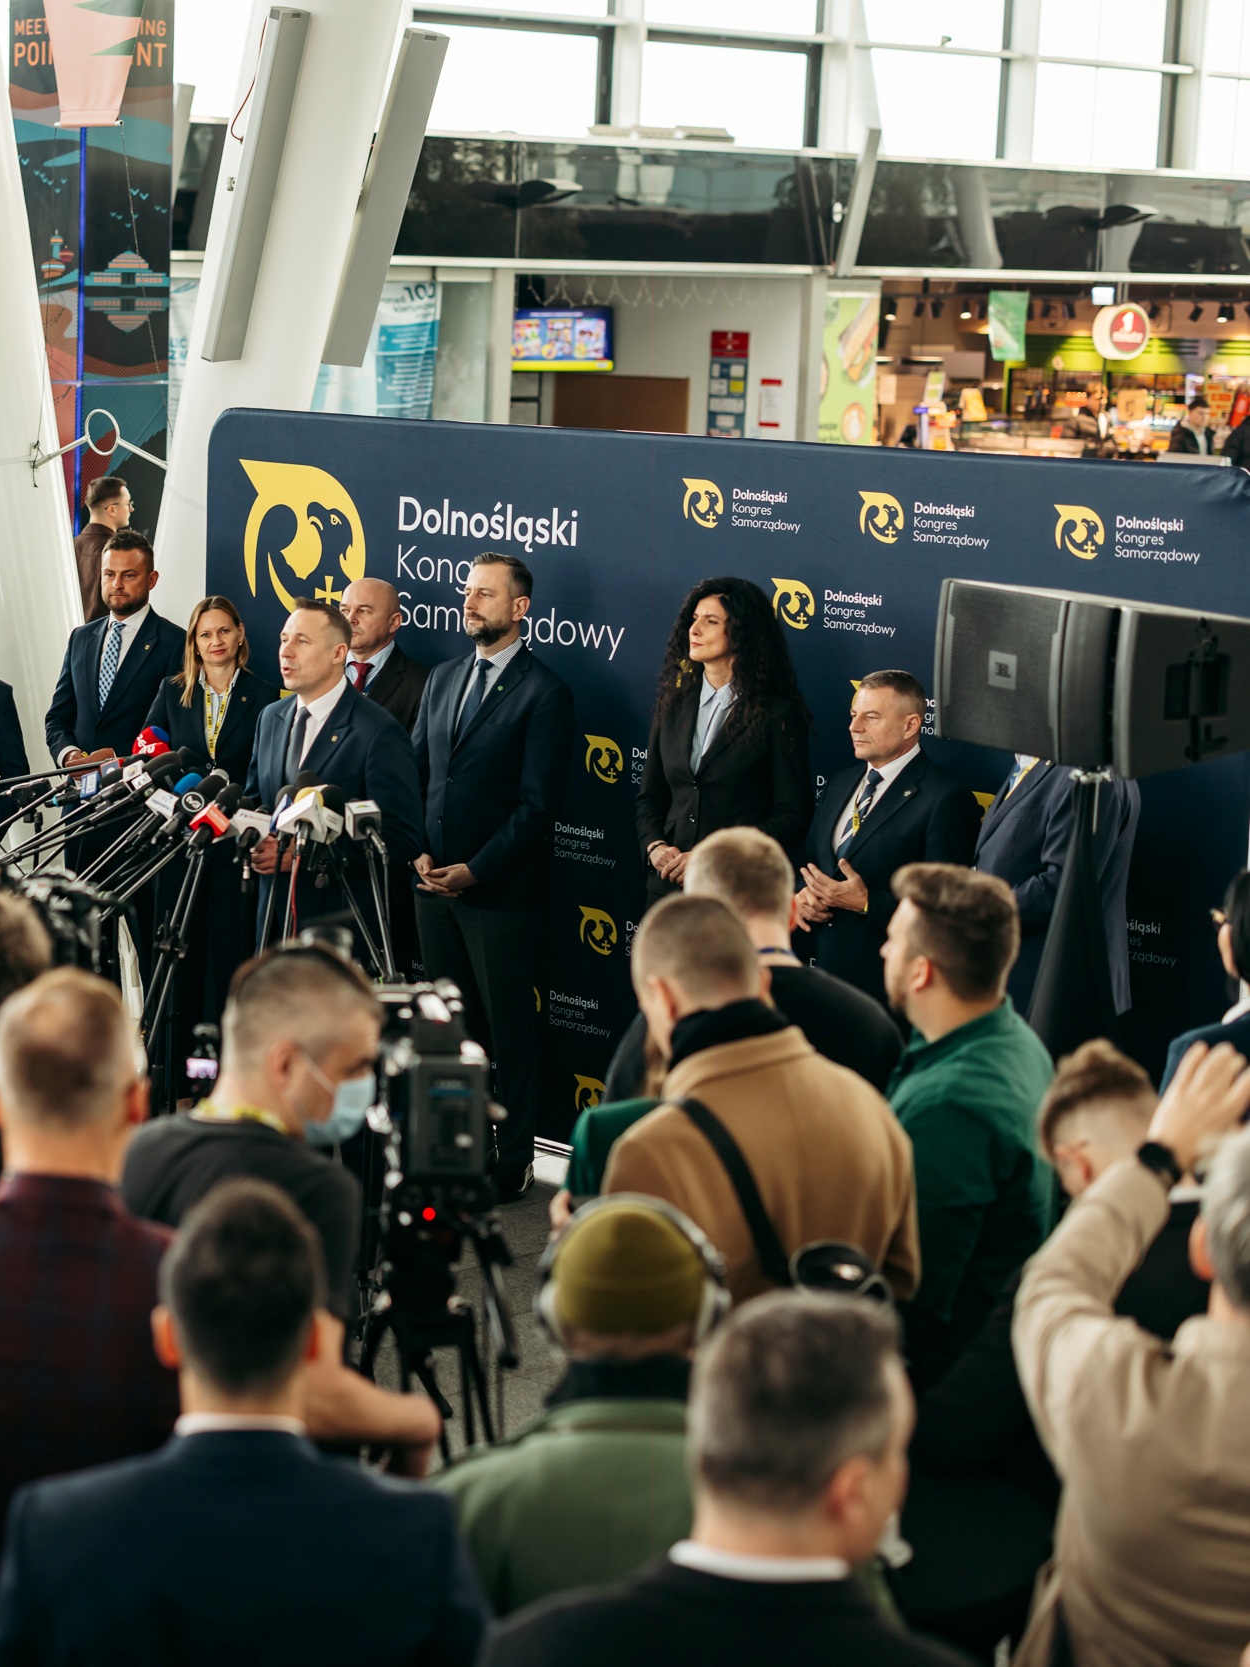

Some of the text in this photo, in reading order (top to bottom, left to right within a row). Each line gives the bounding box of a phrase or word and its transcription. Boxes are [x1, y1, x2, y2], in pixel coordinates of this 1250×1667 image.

[132, 42, 168, 67] NT
[732, 488, 788, 504] Dolnośląski
[732, 502, 772, 517] Kongres
[914, 502, 975, 518] Dolnośląski
[398, 495, 578, 553] Dolnośląski
[731, 515, 801, 534] Samorządowy
[913, 516, 958, 531] Kongres
[1115, 515, 1184, 532] Dolnośląski
[912, 530, 990, 549] Samorządowy
[1115, 530, 1165, 547] Kongres
[1114, 545, 1201, 565] Samorządowy
[396, 543, 474, 595] Kong
[824, 589, 882, 606] Dolnośląski
[823, 603, 866, 619] Kongres
[397, 591, 625, 661] Samądowy
[823, 617, 896, 637] Samorządowy
[554, 821, 604, 840] Dolnośląski
[554, 835, 590, 850] Kongres
[554, 847, 617, 869] Samorządowy
[549, 990, 599, 1010] Dolnośląski
[549, 1002, 585, 1019] Kongres
[549, 1014, 611, 1039] Samorządowy
